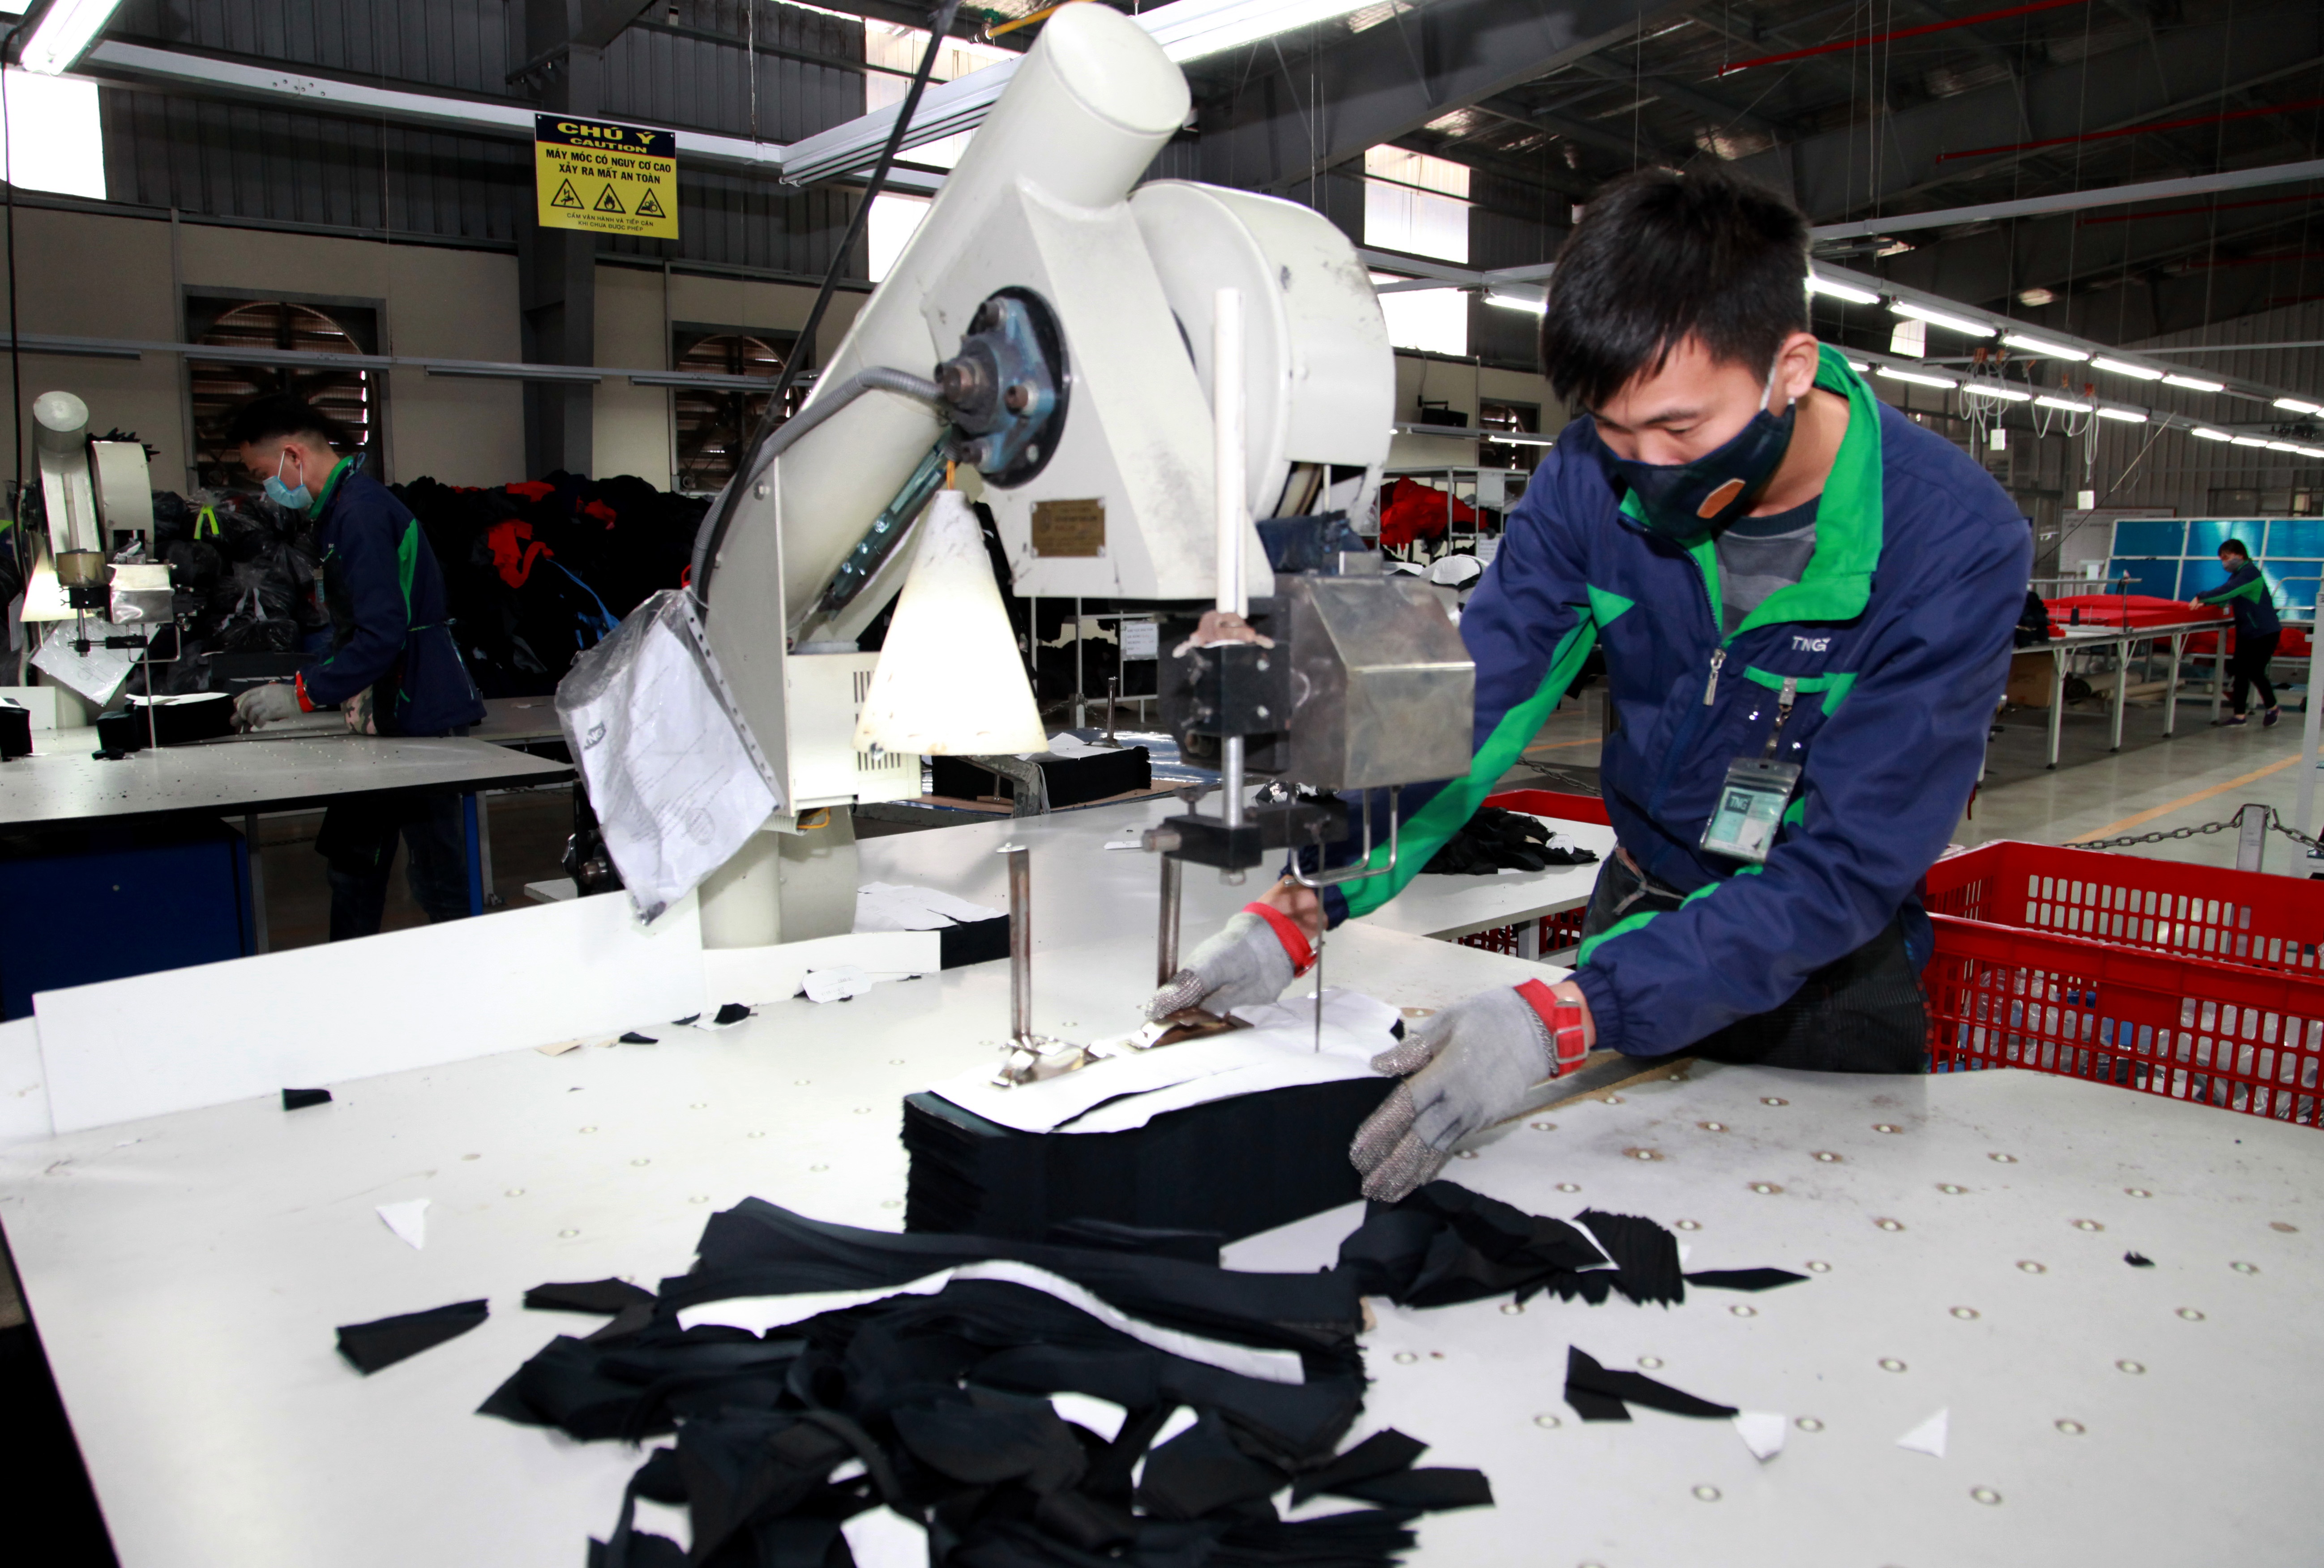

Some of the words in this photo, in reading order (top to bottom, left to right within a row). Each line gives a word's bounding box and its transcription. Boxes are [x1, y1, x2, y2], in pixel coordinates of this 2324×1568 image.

[557, 122, 623, 140] CHÚ
[635, 131, 656, 145] Ý
[570, 137, 647, 153] CAUTION
[546, 148, 567, 160] MÁY
[571, 151, 592, 163] MÓC
[595, 154, 608, 165] CÓ
[611, 157, 635, 168] NGUY
[638, 161, 651, 170] CƠ
[653, 163, 671, 172] CAO
[559, 161, 578, 174] XẢY
[582, 167, 594, 176] RA
[598, 167, 617, 179] MẤT
[621, 171, 633, 181] AN
[636, 172, 660, 184] TOÀN
[1792, 635, 1831, 652] TNG
[1729, 794, 1749, 810] TNG
